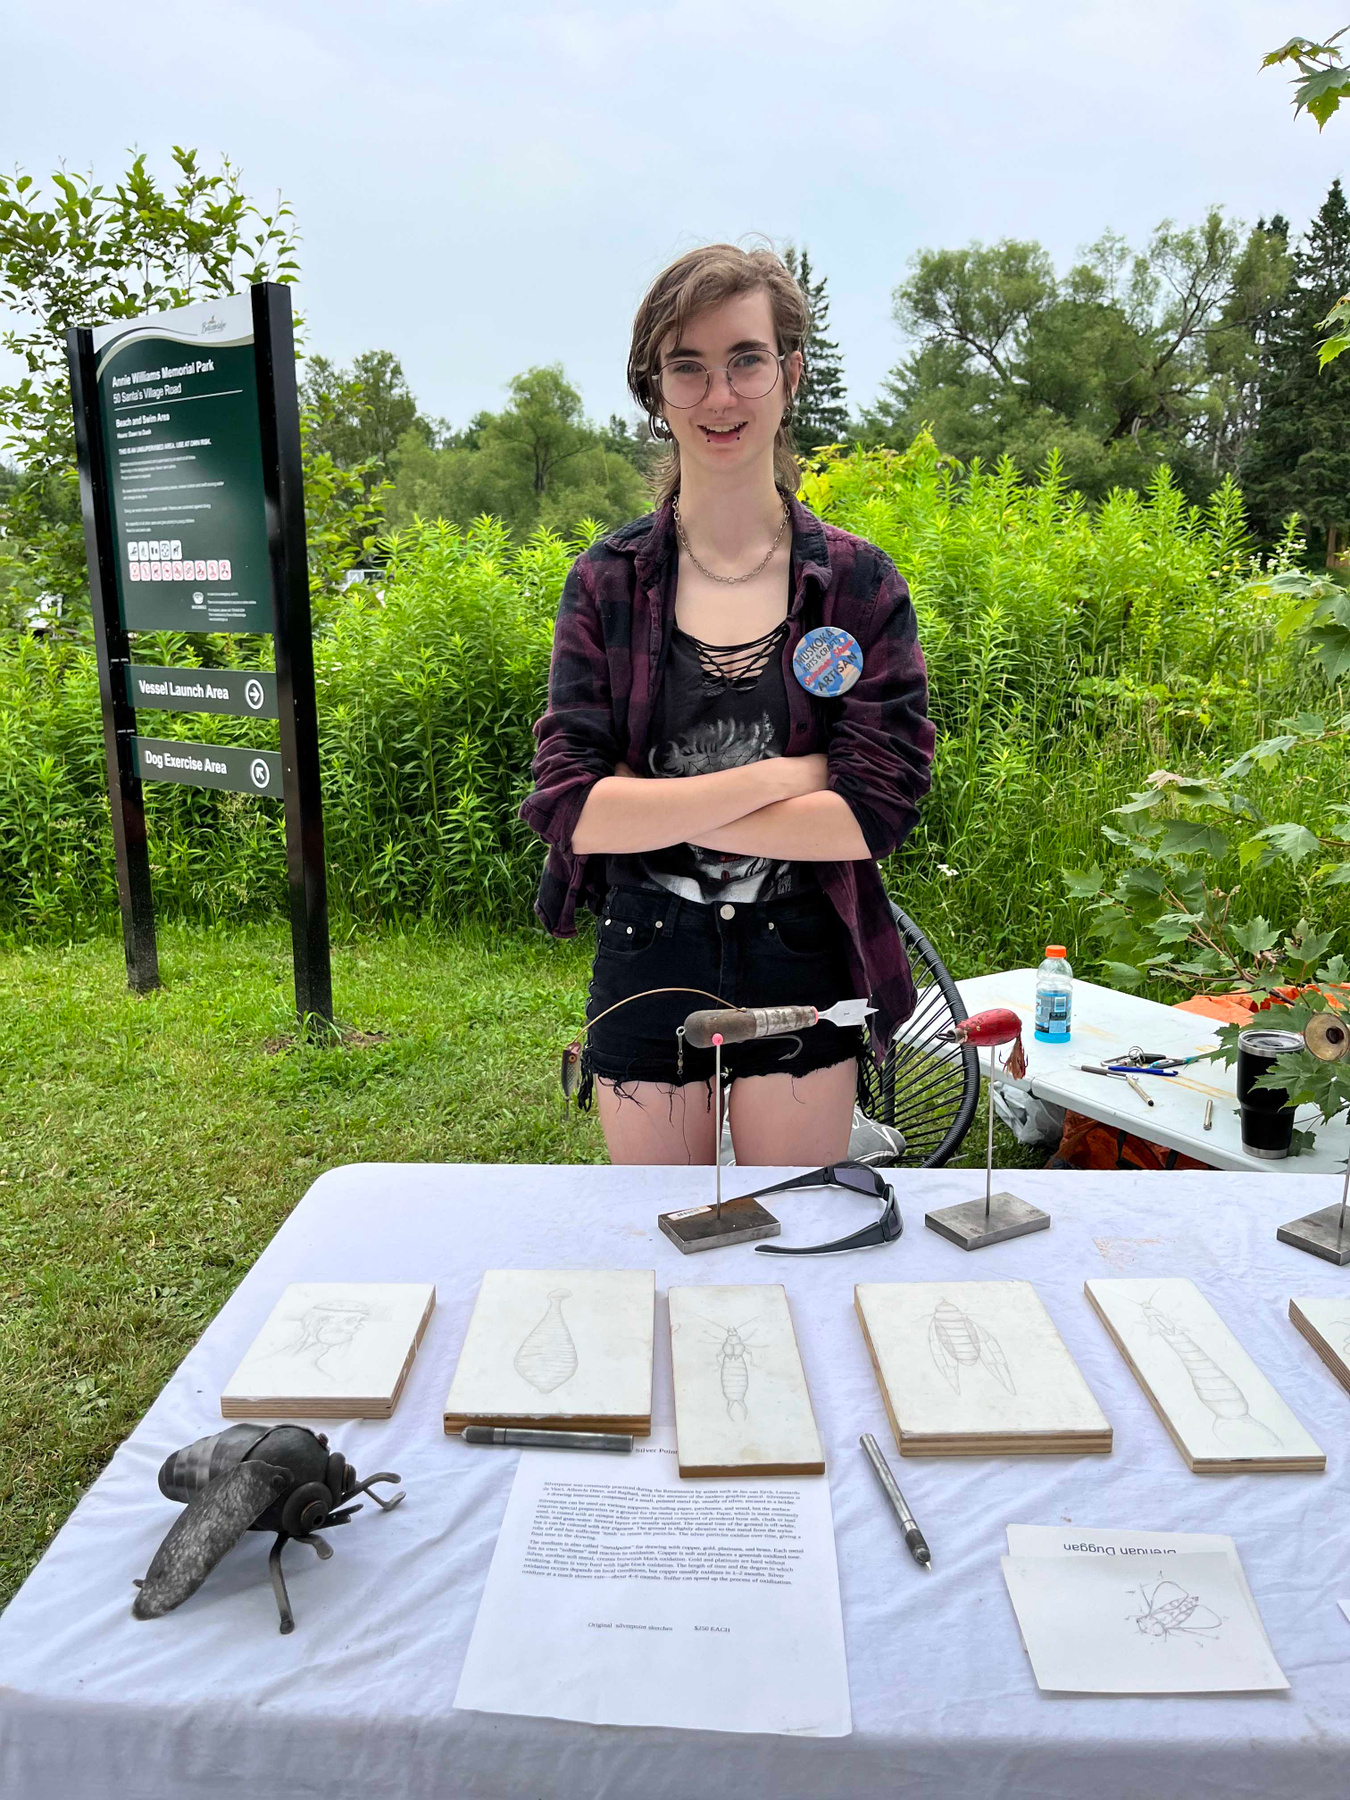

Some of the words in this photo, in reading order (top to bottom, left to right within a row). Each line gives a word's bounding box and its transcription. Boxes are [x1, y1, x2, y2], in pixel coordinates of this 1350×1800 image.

[112, 375, 131, 388] Annie
[132, 371, 161, 385] Williams
[162, 363, 195, 379] Memorial
[196, 359, 214, 373] Park
[113, 393, 121, 404] 50
[122, 390, 143, 402] Santa's
[144, 386, 164, 400] Village
[165, 383, 182, 395] Road
[157, 412, 170, 422] Area
[794, 629, 835, 667] MUSKOKA
[803, 656, 818, 673] ARTS
[820, 637, 841, 656] CRAFTS
[817, 652, 858, 691] ARTISAN
[138, 680, 168, 695] Vessel
[170, 682, 205, 697] Launch
[206, 684, 229, 699] Area
[145, 751, 164, 768] Dog
[165, 753, 202, 770] Exercise
[204, 759, 227, 774] Area
[1064, 1543, 1116, 1555] Duggan
